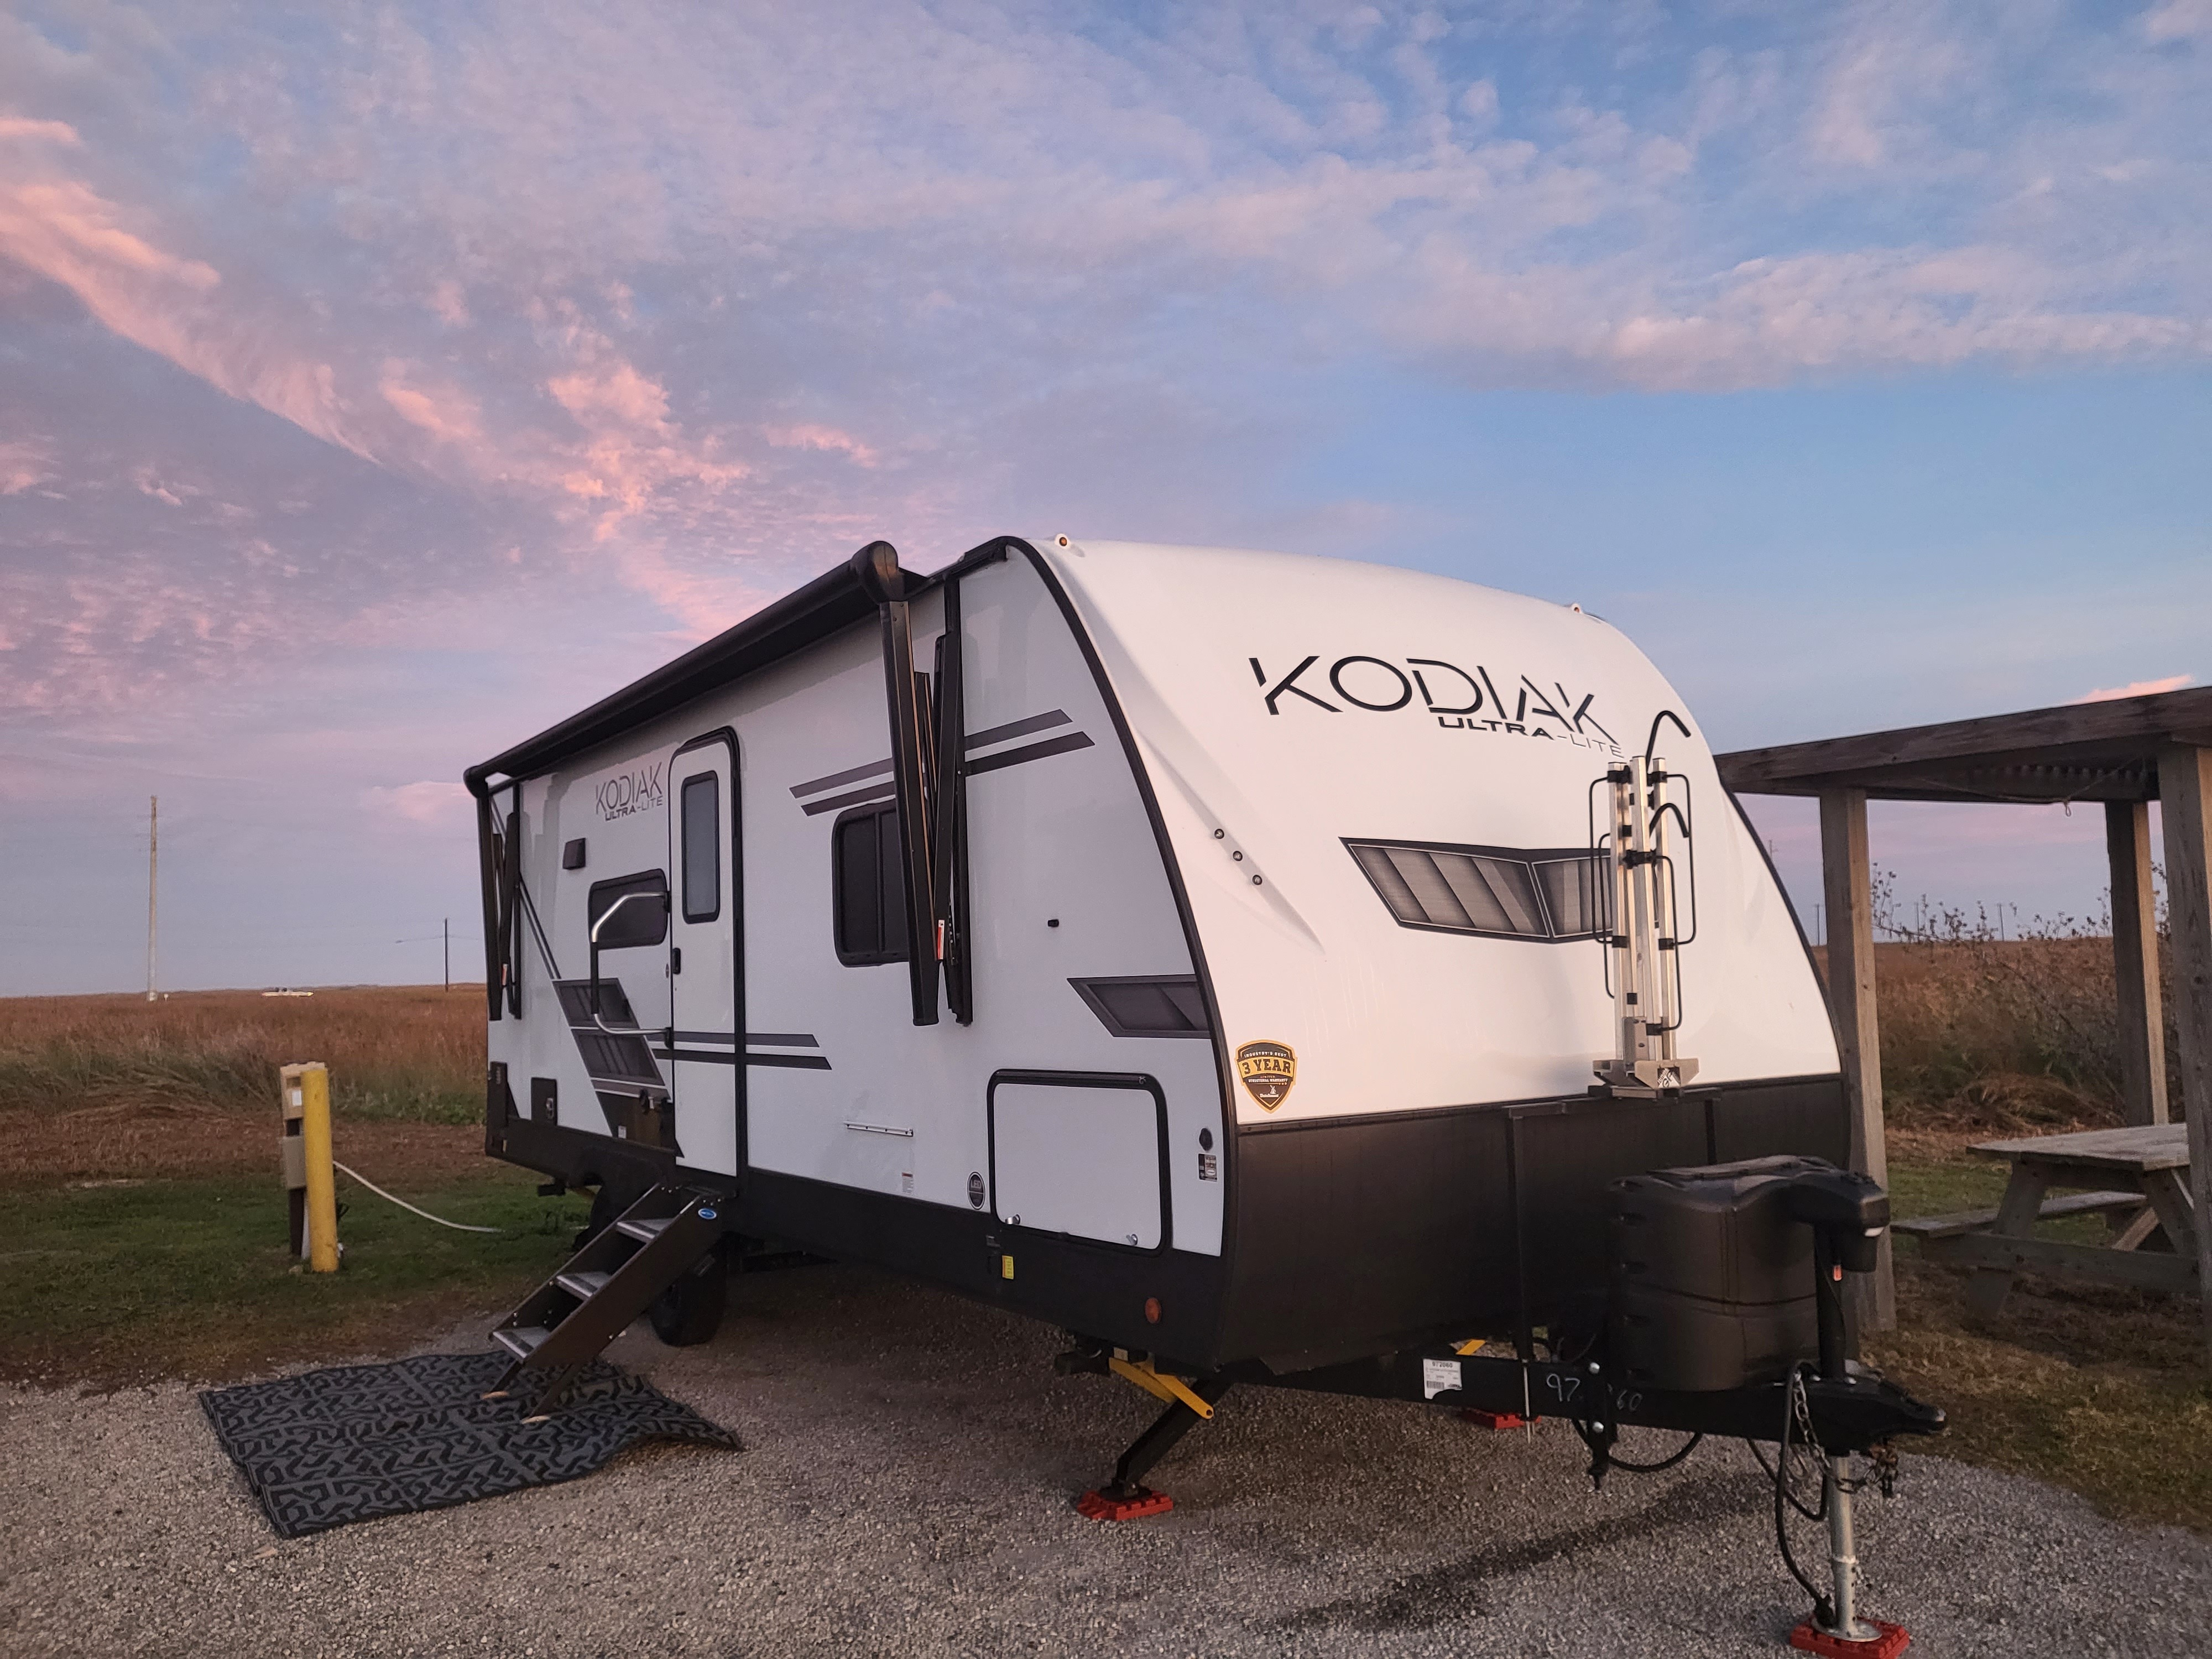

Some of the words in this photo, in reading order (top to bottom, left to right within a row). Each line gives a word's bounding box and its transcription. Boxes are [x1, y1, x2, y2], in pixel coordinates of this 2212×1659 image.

[1248, 655, 1620, 745] KODIAK
[1437, 716, 1625, 759] ULTRA-LITE
[596, 761, 662, 815] KODIAK
[604, 795, 664, 821] ULTRA-LITE
[1242, 1062, 1250, 1074] 3
[1253, 1059, 1290, 1073] YEAR
[971, 1180, 982, 1189] LED
[1546, 1373, 1581, 1402] 97
